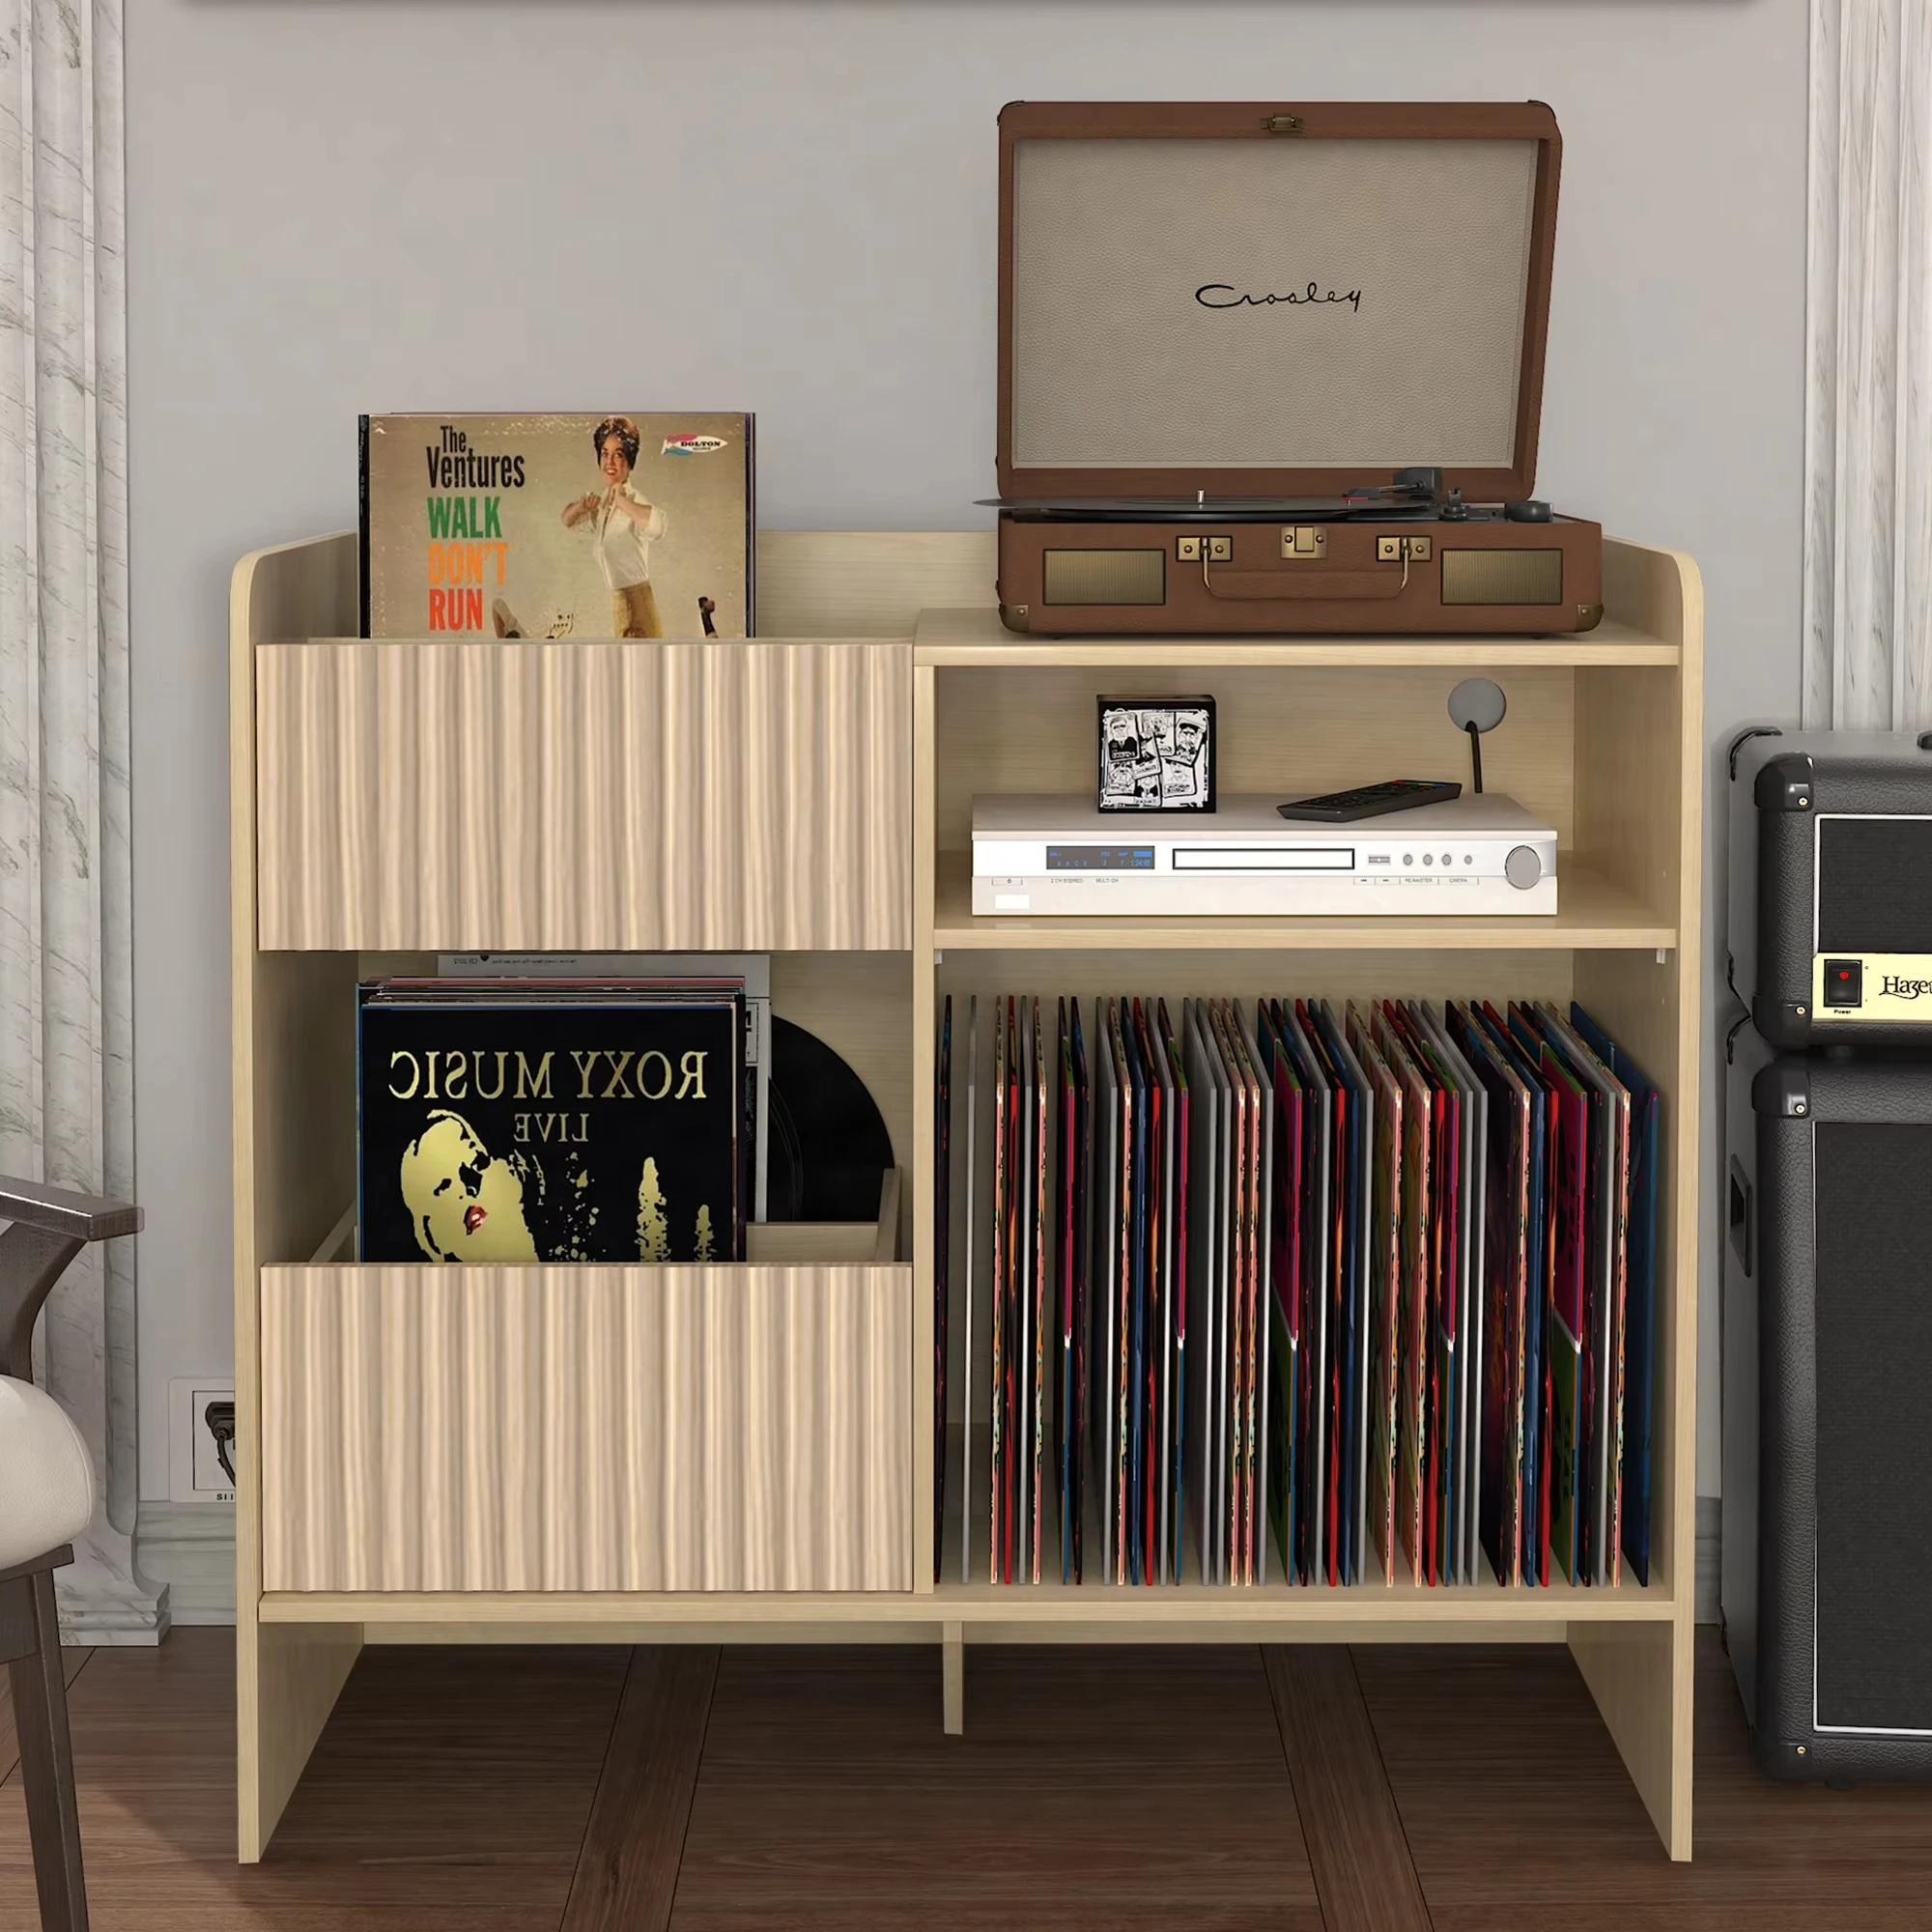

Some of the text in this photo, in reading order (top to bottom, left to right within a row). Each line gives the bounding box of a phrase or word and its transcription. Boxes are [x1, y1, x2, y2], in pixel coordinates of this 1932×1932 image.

[1195, 281, 1361, 313] Crosley
[440, 425, 467, 452] The
[425, 445, 526, 489] Ventures
[427, 496, 502, 539] WALK
[427, 542, 509, 586] DON'T
[428, 588, 483, 632] RUN
